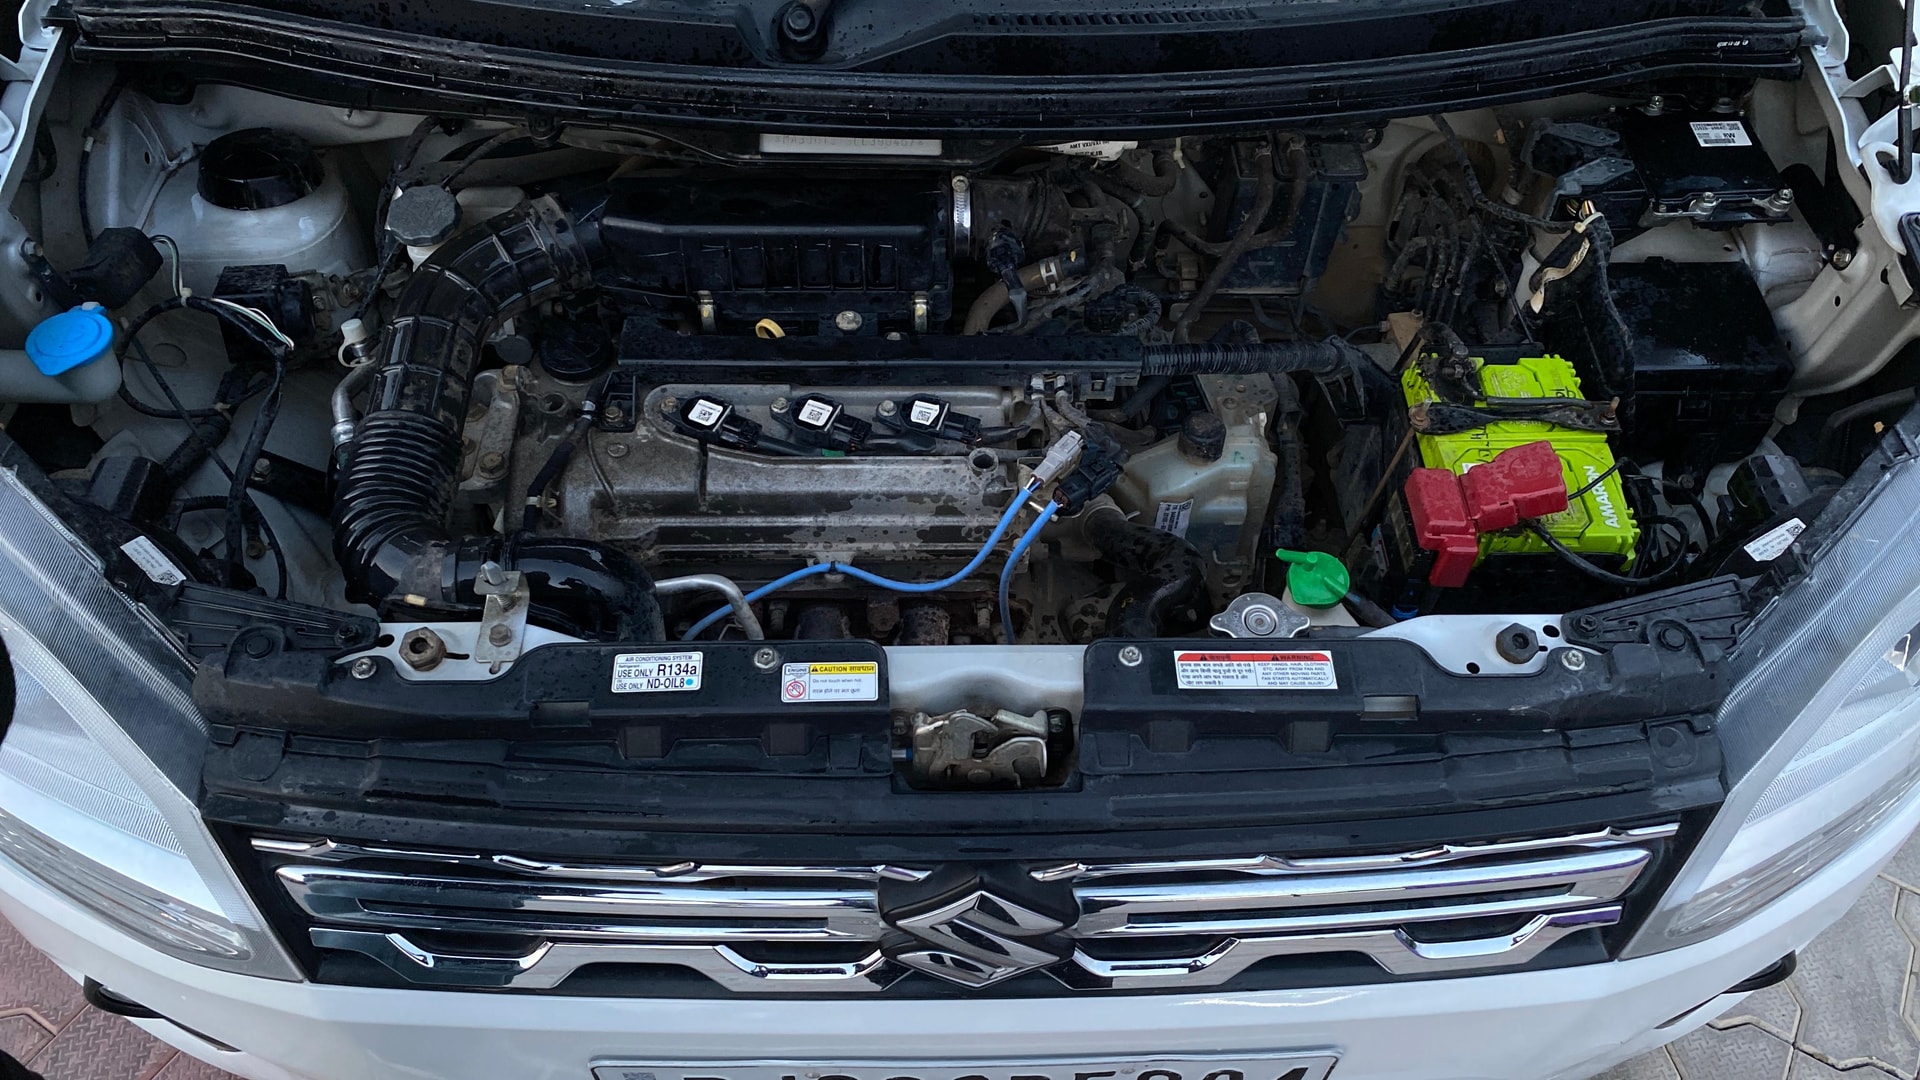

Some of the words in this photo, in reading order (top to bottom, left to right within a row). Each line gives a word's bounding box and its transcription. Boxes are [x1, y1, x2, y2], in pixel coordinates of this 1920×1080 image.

[634, 669, 653, 677] ONLY
[657, 663, 697, 676] R134a
[647, 678, 685, 688] ND-OIL8
